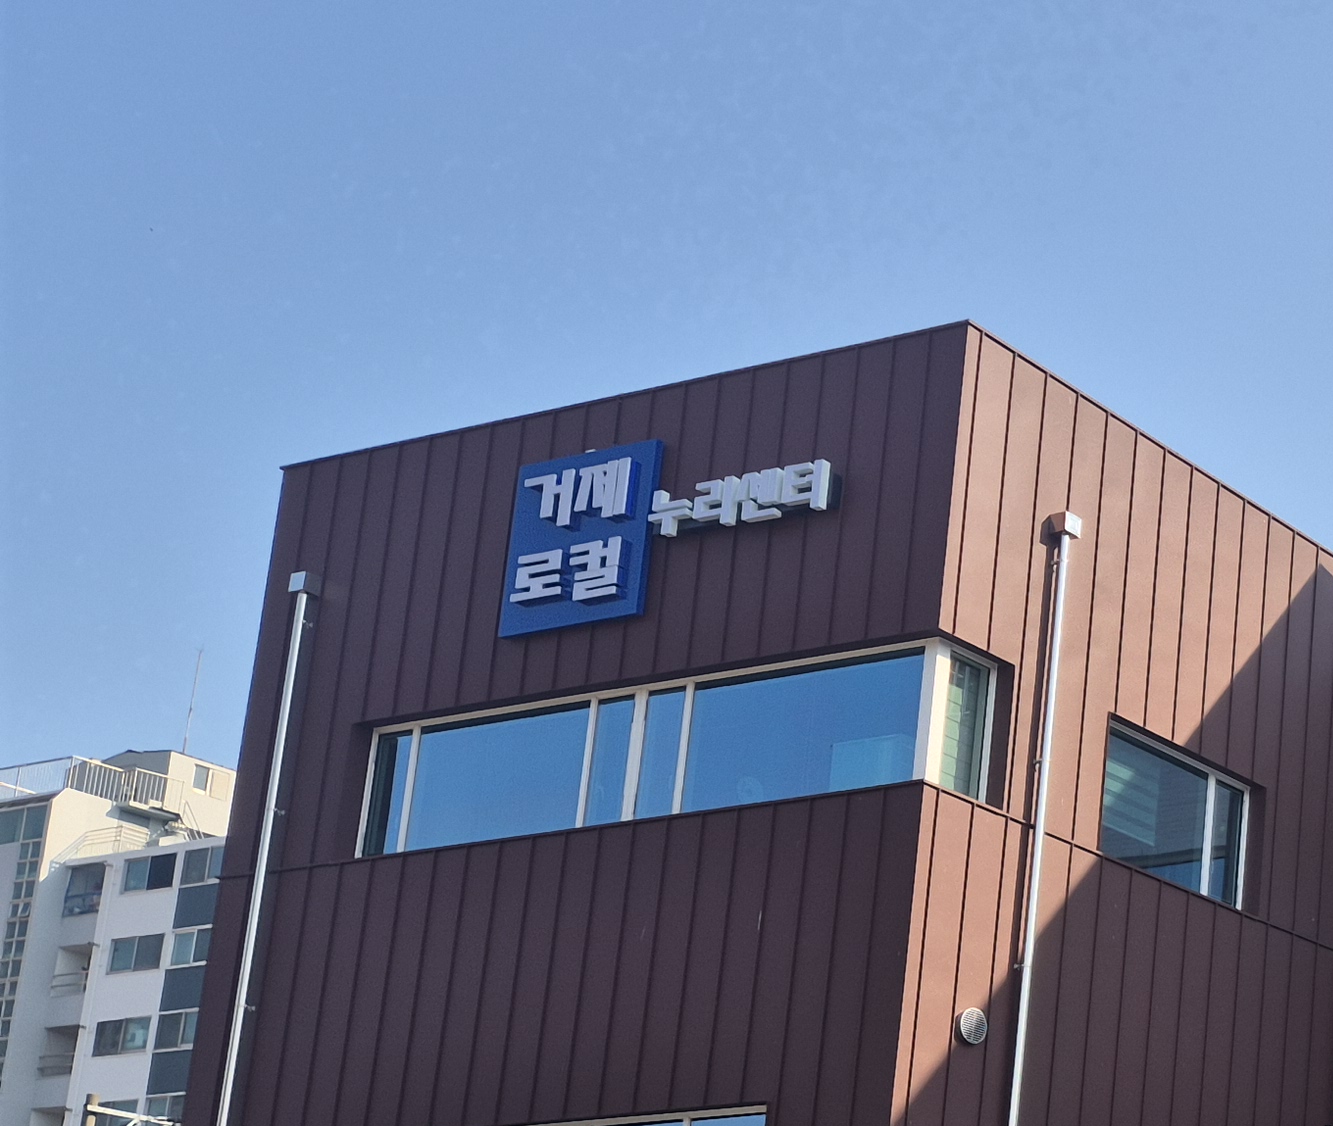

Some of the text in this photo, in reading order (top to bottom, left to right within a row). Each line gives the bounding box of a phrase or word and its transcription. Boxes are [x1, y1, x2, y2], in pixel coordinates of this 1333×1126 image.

[524, 457, 633, 527] 거제
[648, 458, 832, 538] 누리센터
[509, 536, 623, 602] 로컬
